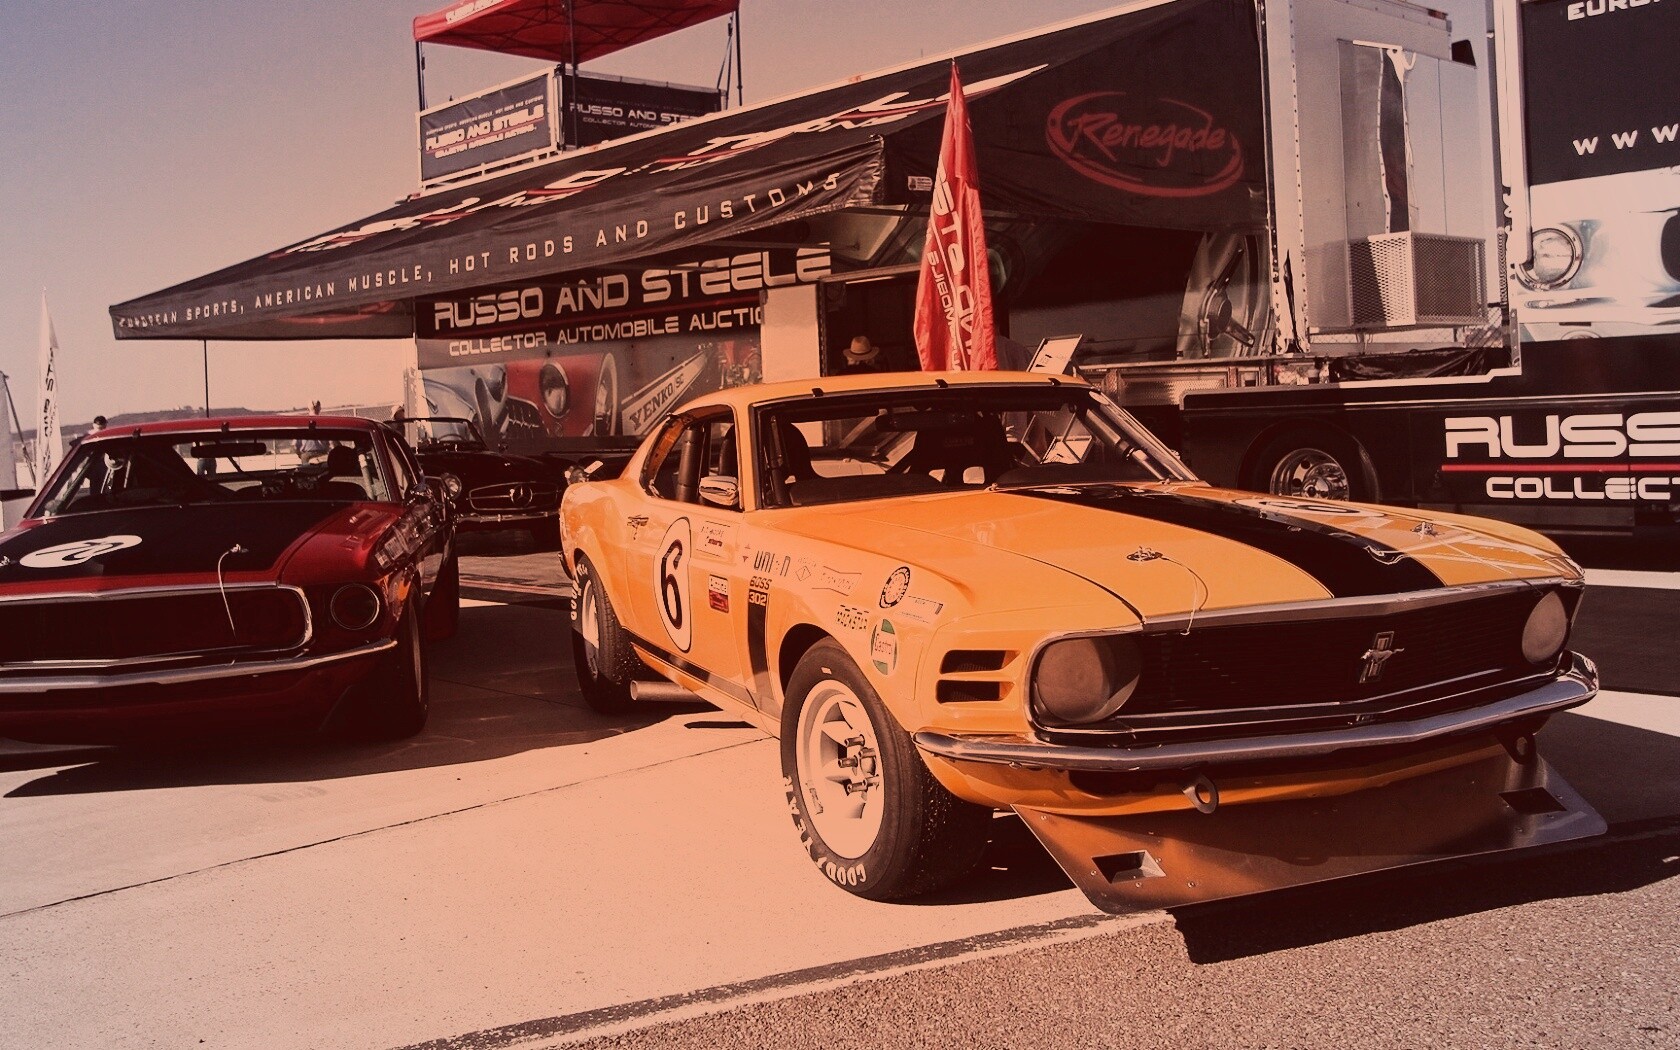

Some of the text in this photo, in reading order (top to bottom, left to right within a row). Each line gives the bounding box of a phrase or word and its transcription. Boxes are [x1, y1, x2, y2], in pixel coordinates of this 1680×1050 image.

[1567, 0, 1661, 21] EURO
[570, 103, 623, 118] RUSSO
[628, 109, 657, 121] AND
[582, 117, 626, 127] COLLECTOR
[1068, 112, 1226, 167] Renegade
[186, 299, 244, 322] SPORTS,
[254, 283, 335, 309] AMERICAN
[349, 265, 433, 292] MUSCLE,
[450, 252, 490, 275] HOT
[510, 236, 573, 263] RODS
[596, 220, 648, 248] AND
[674, 173, 840, 231] CUSTOMS
[435, 242, 831, 331] RUSSO AND STEELE
[449, 330, 547, 357] COLLECTOR
[557, 315, 679, 345] AUTOMOBILE
[1445, 411, 1680, 458] RUSS
[754, 550, 791, 577] UNIN
[661, 539, 683, 630] 6
[748, 591, 767, 607] 302
[750, 575, 772, 590] BOSS
